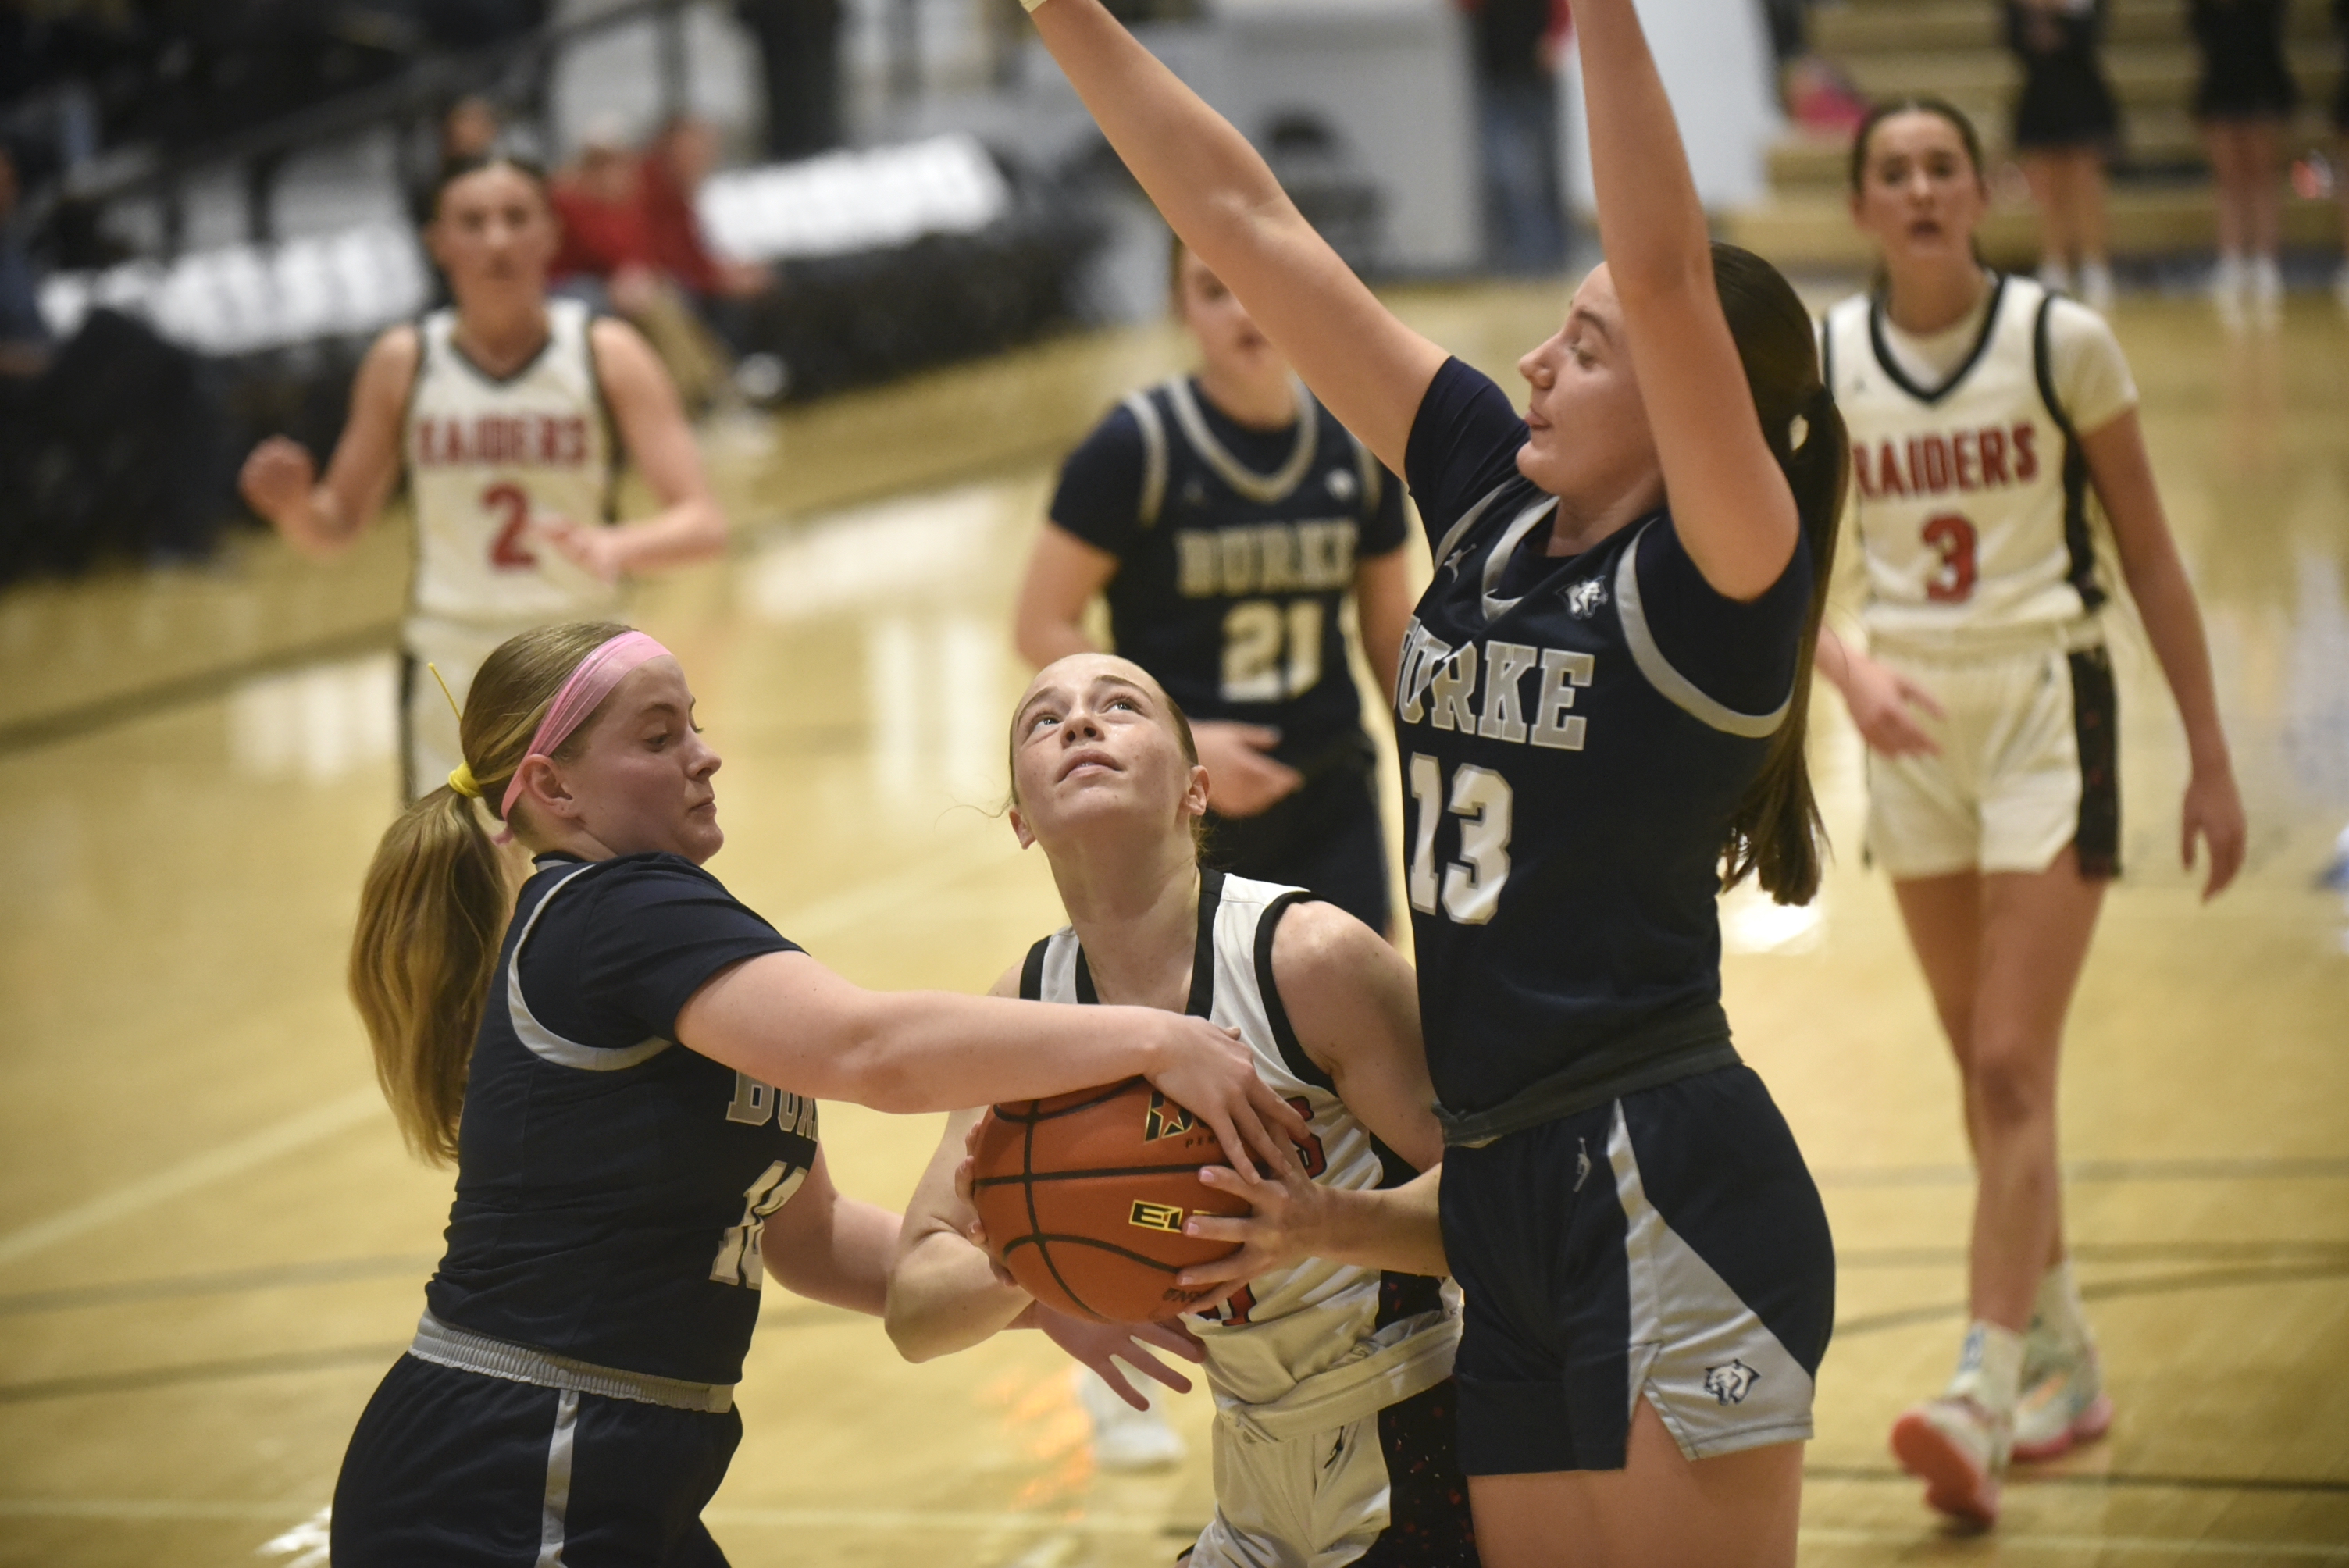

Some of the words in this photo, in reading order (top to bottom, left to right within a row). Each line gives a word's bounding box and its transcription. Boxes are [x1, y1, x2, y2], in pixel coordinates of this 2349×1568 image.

[480, 481, 538, 572] 2
[1175, 518, 1359, 598] BURKE
[1923, 511, 1978, 606] 3
[1219, 600, 1323, 700] 21
[1409, 751, 1513, 925] 13
